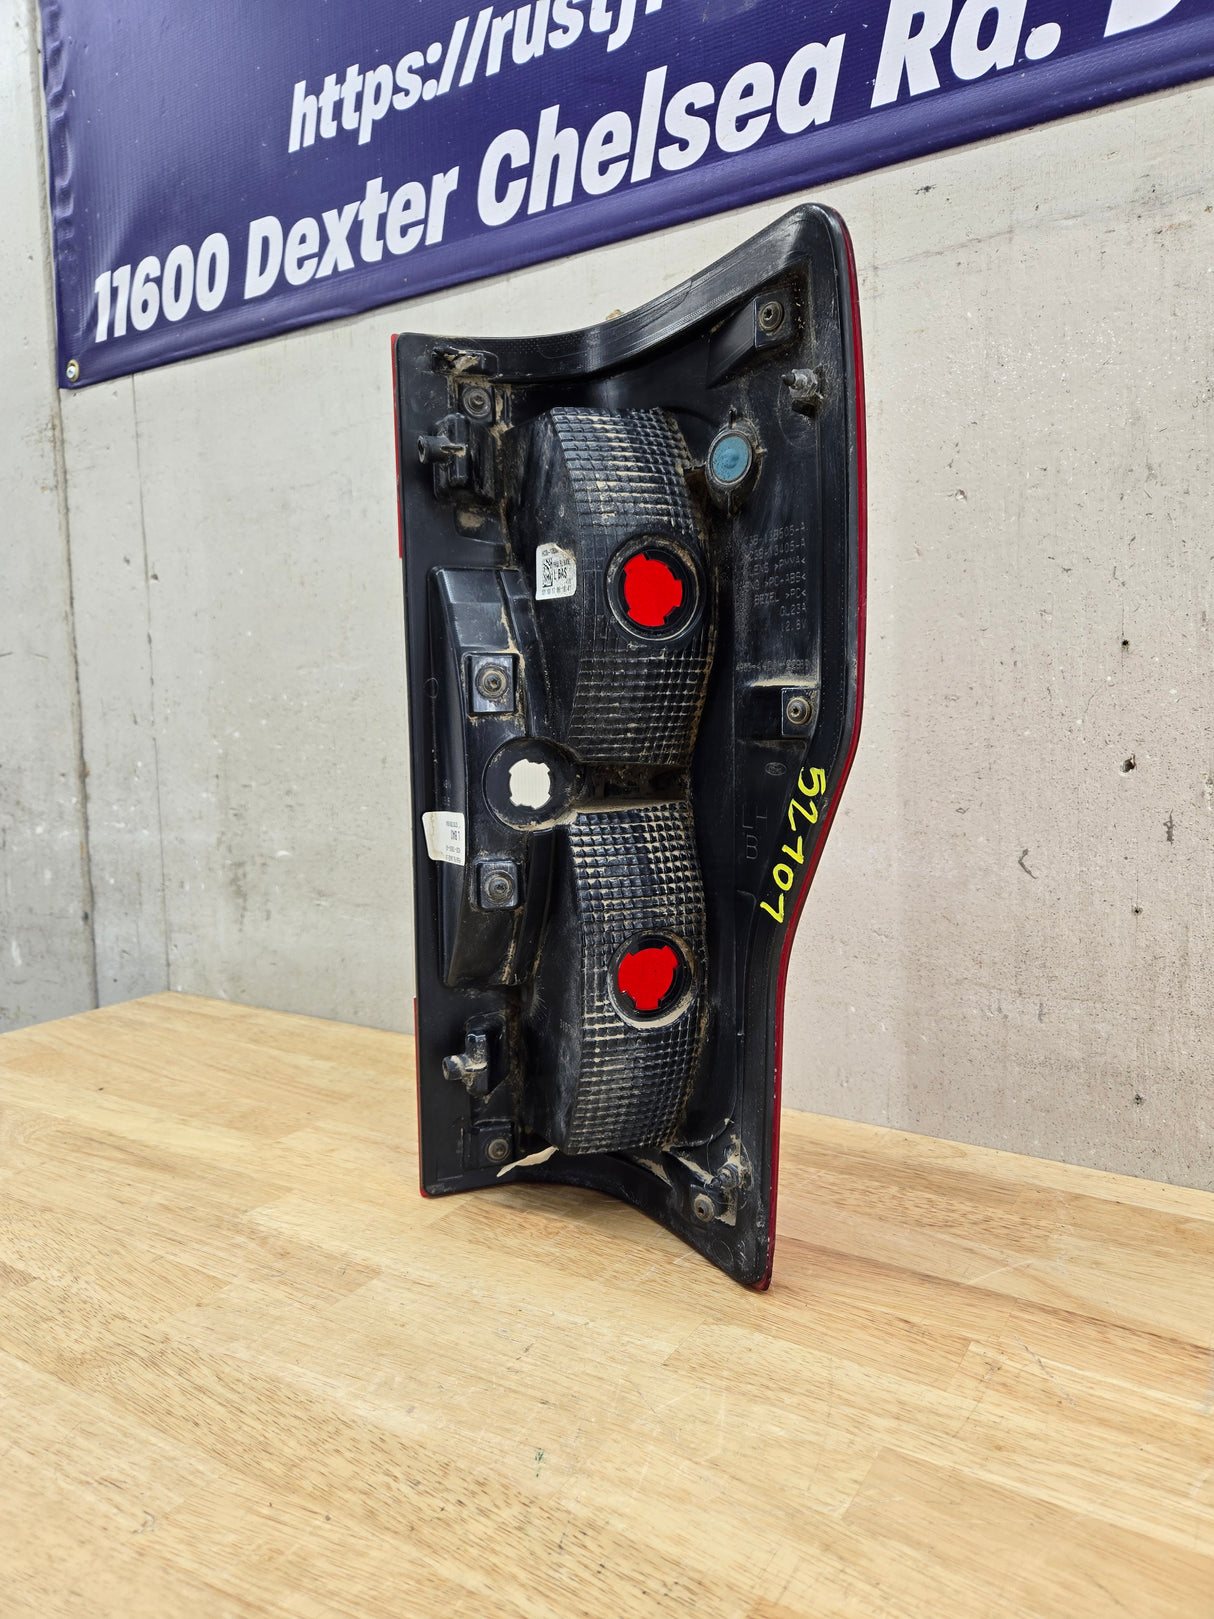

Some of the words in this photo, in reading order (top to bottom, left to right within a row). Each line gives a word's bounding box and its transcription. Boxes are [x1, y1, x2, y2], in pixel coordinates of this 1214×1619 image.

[93, 232, 230, 343] 11600
[245, 165, 460, 299] Dexter
[478, 33, 846, 226] Chelsea
[288, 0, 663, 153] https://rustj
